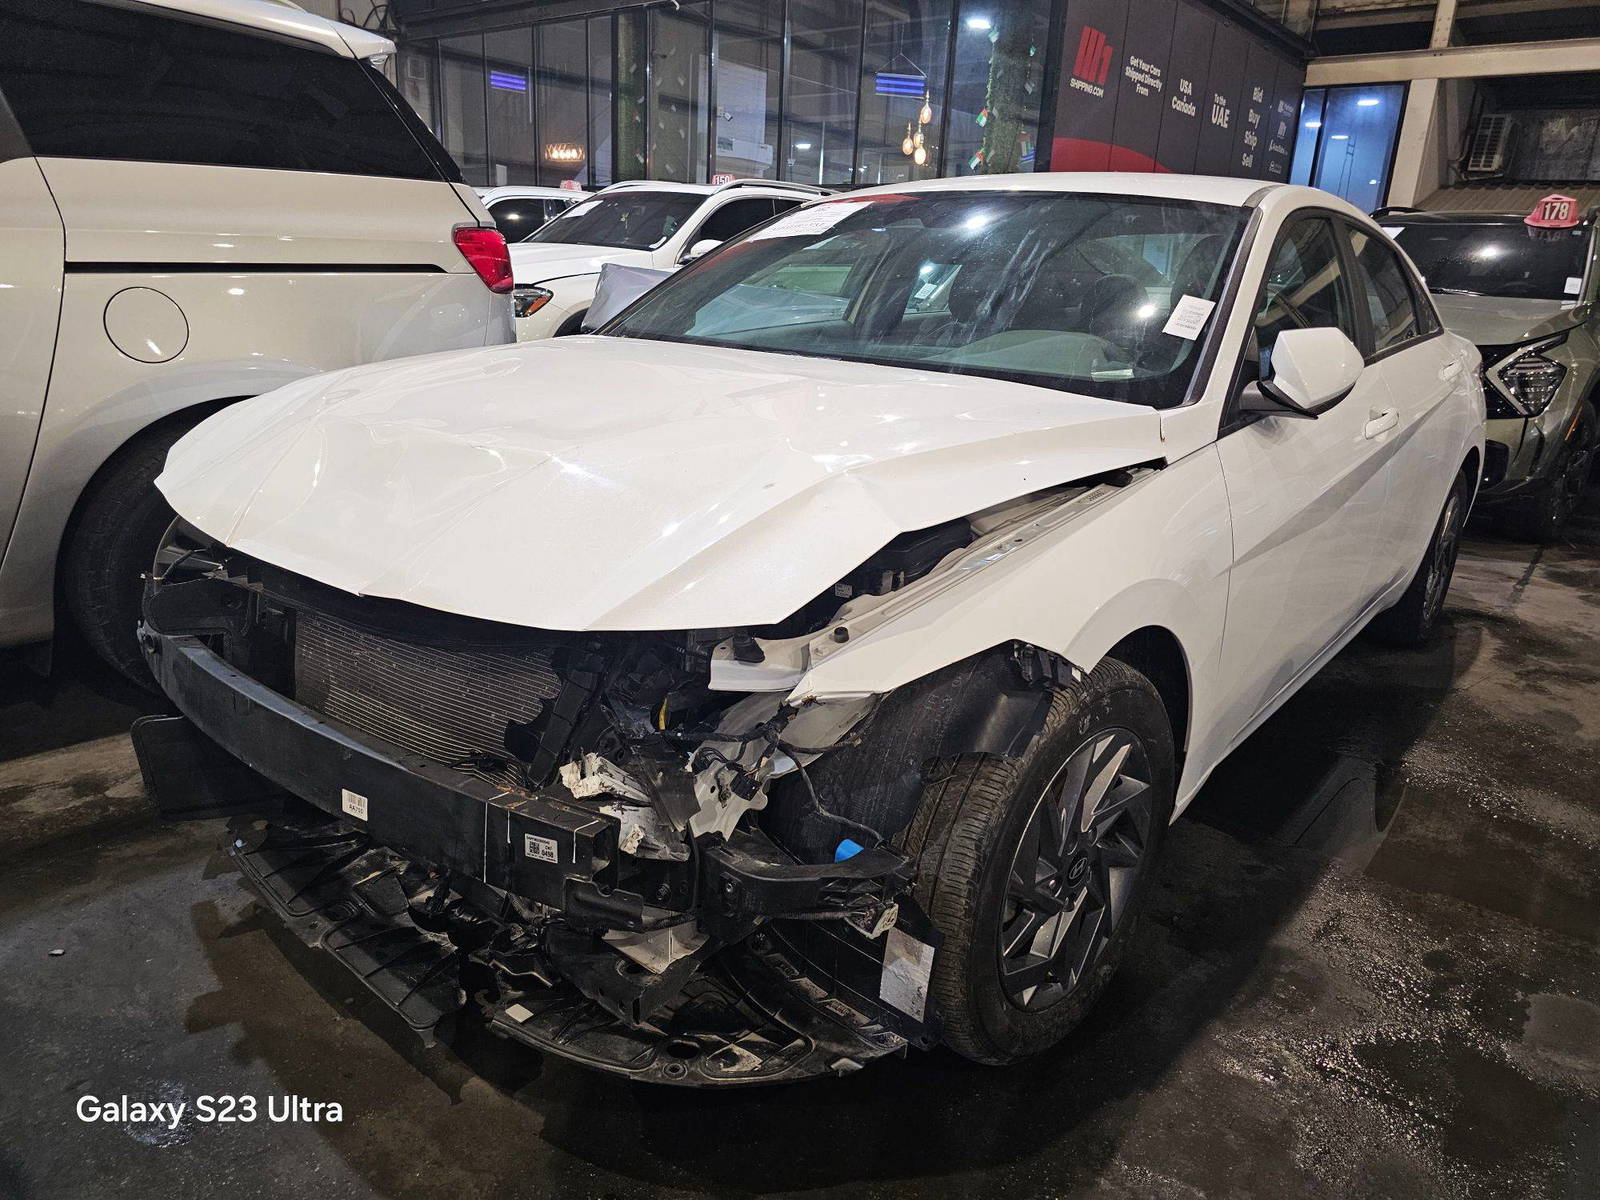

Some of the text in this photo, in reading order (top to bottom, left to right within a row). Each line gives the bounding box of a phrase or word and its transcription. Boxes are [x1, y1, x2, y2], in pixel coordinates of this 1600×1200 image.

[1069, 78, 1105, 98] SHIPPING.COM
[1180, 79, 1192, 95] USA
[1172, 96, 1197, 117] Canada
[1211, 104, 1230, 129] UAE
[1248, 108, 1261, 129] Buy
[1242, 153, 1254, 168] Sell
[1544, 202, 1569, 220] 178
